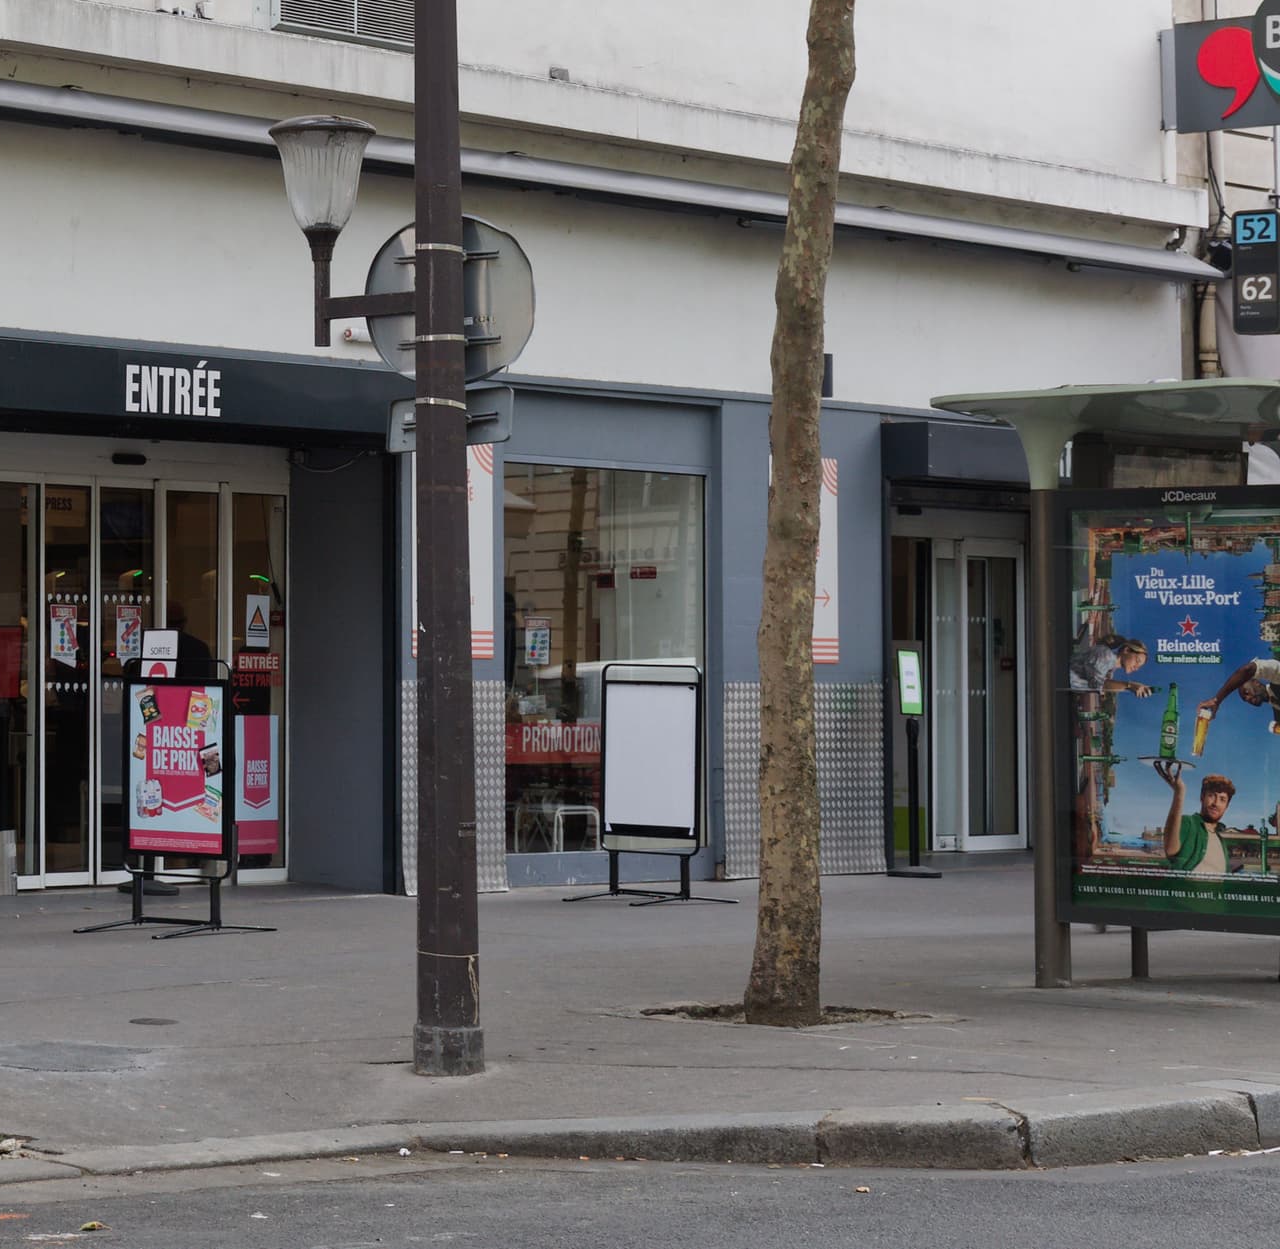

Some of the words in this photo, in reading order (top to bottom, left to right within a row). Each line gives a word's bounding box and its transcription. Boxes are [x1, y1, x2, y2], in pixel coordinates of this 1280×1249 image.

[1242, 217, 1271, 240] 52
[1242, 276, 1272, 301] 62
[125, 360, 221, 417] ENTRÉE
[1161, 490, 1217, 502] JCDecaux
[1150, 567, 1164, 577] Du
[1135, 575, 1215, 590] Vieux-Lille
[1145, 590, 1157, 599] au
[150, 646, 172, 656] SORTIE
[1157, 639, 1220, 652] Heineken
[1158, 655, 1171, 663] Une
[1174, 655, 1196, 663] même
[153, 726, 198, 748] BAISSE
[522, 726, 601, 753] PROMOTION
[152, 749, 169, 769] DE
[170, 750, 199, 771] PRIX
[1260, 895, 1274, 903] AVEC
